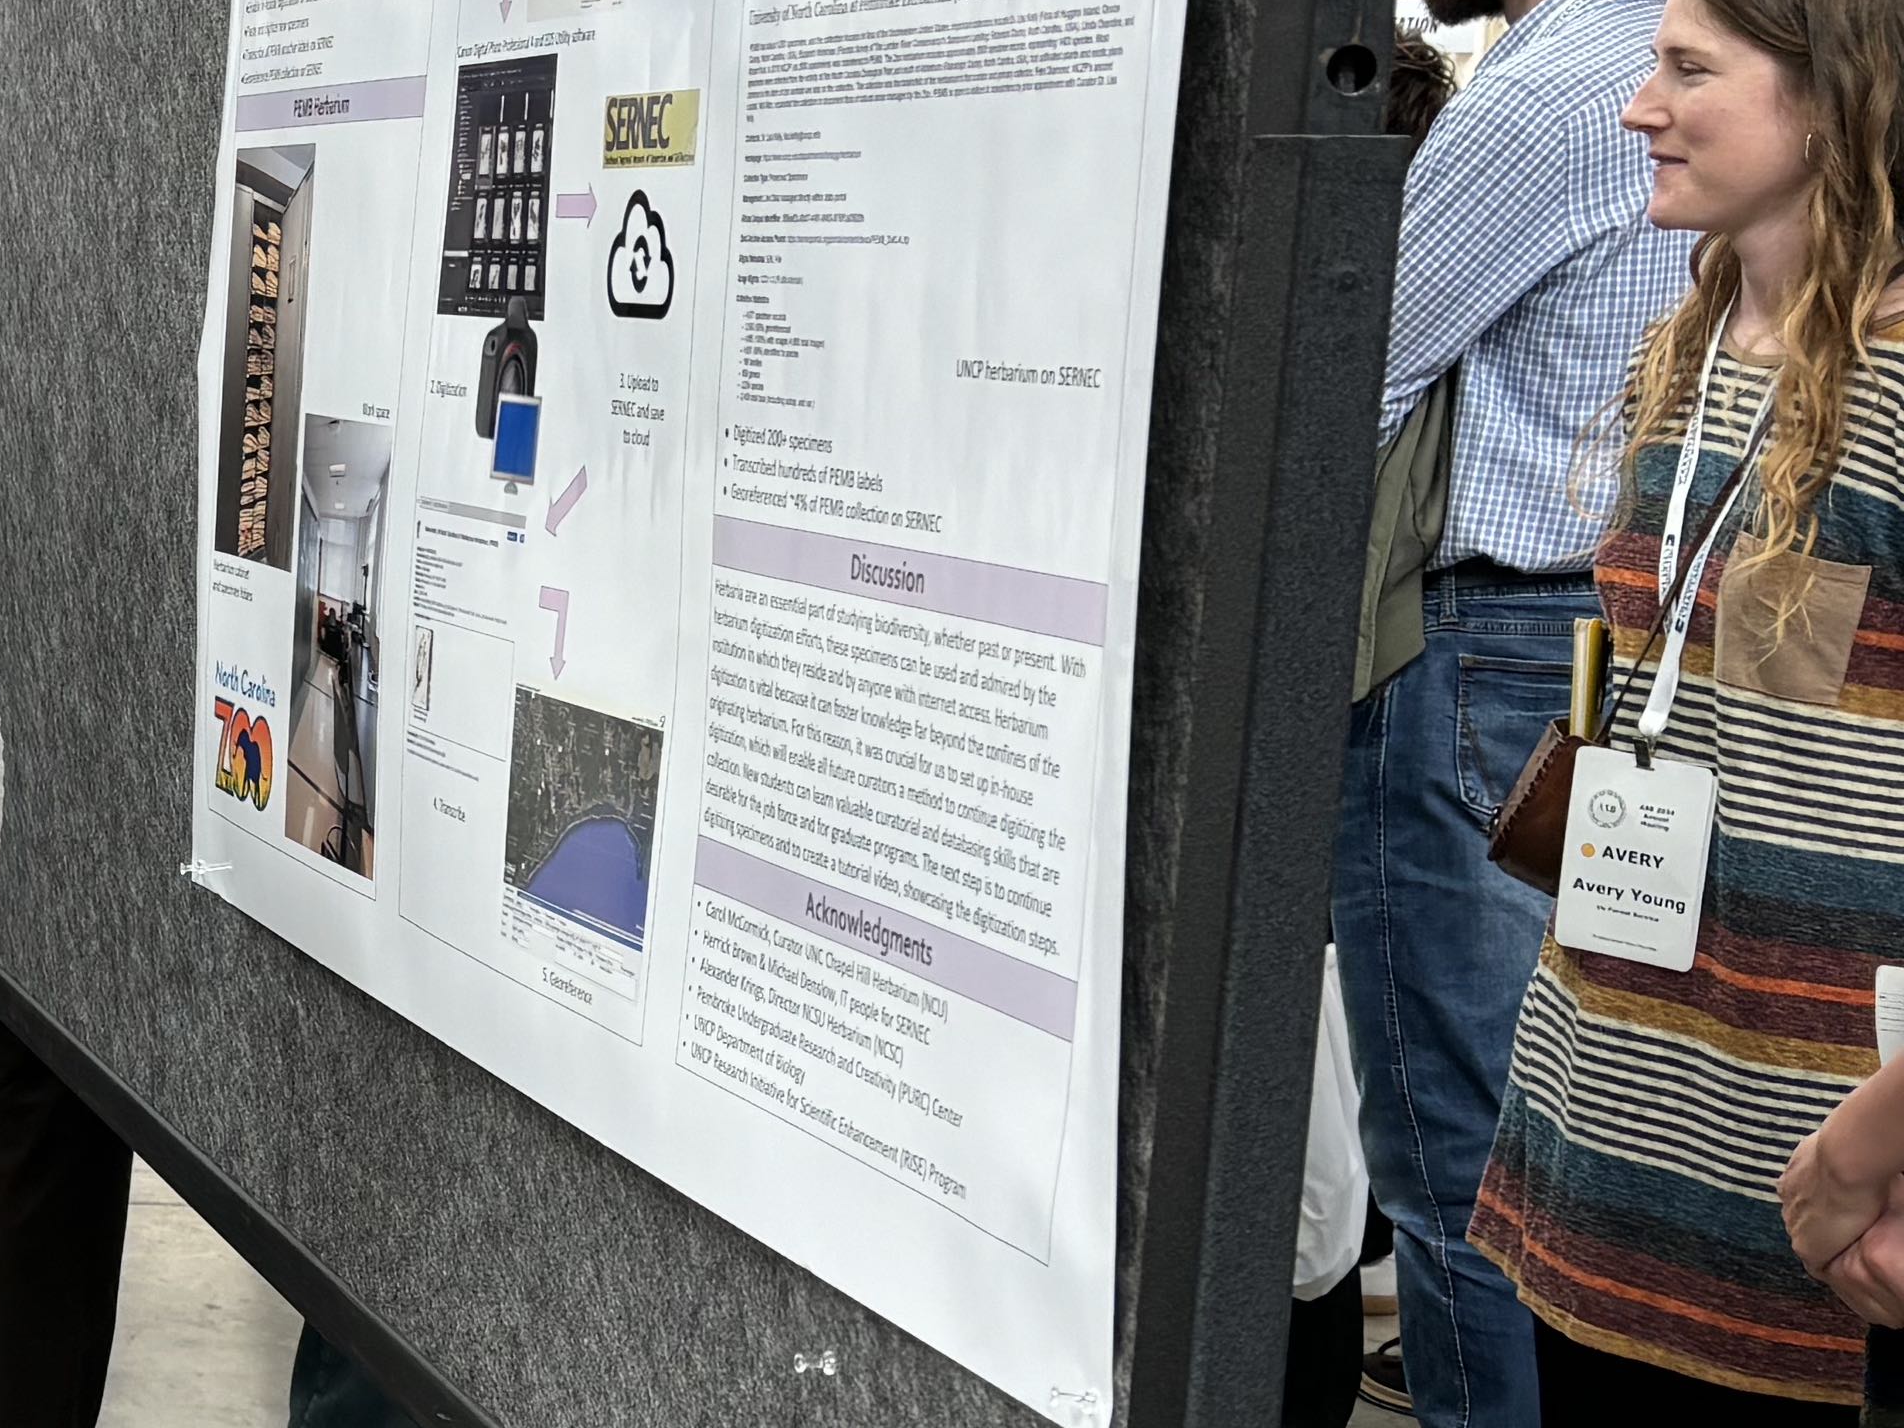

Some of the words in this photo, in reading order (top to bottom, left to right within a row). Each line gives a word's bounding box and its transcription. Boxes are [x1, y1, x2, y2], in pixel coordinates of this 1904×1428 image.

[604, 92, 672, 152] SERNEC
[956, 360, 983, 378] UNCP
[1040, 370, 1055, 383] on
[1058, 366, 1101, 387] SERNEC
[733, 424, 766, 445] Digitized
[788, 436, 832, 452] specimens
[732, 454, 776, 475] Transcribed
[777, 461, 816, 481] hundreds
[818, 466, 828, 483] of
[829, 468, 854, 487] PEMB
[856, 471, 882, 491] labels
[731, 483, 788, 507] Georeferenced
[809, 495, 818, 511] of
[819, 497, 844, 516] PEMB
[845, 502, 889, 522] collection
[891, 512, 903, 525] on
[904, 511, 942, 532] SERNEC
[850, 554, 924, 591] Discussion
[214, 662, 238, 690] North
[240, 670, 275, 706] Carolina
[214, 697, 273, 812] ZOO
[1602, 846, 1665, 869] AVERY
[1573, 877, 1624, 900] Avery
[1631, 888, 1686, 914] Young
[805, 894, 932, 964] Acknowledgments
[703, 931, 730, 953] Herrick
[731, 942, 756, 965] Brown
[759, 953, 765, 969] &
[767, 957, 798, 984] Michael
[839, 989, 848, 1006] IT
[849, 998, 878, 1021] people
[881, 1006, 893, 1026] for
[895, 1014, 930, 1044] SERNEC
[706, 901, 725, 921] Carol
[773, 930, 802, 954] Curator
[805, 944, 822, 965] UNC
[825, 952, 853, 977] Chapel
[855, 964, 870, 984] Hill
[872, 972, 918, 1005] Herbarium
[921, 992, 948, 1022] (NCU)
[699, 958, 737, 986] Alexander
[768, 988, 799, 1013] Director
[802, 1003, 825, 1026] NCSU
[826, 1015, 871, 1048] Herbarium
[873, 1035, 903, 1067] (NCSC)
[694, 1014, 715, 1035] UNCP
[716, 1025, 763, 1061] Department
[765, 1050, 774, 1065] of
[775, 1054, 804, 1084] Biology
[696, 985, 735, 1016] Pembroke
[737, 1005, 796, 1045] Undergraduate
[798, 1033, 835, 1063] Research
[837, 1056, 854, 1073] and
[855, 1061, 895, 1097] Creativity
[898, 1081, 929, 1114] (PURC)
[932, 1098, 962, 1126] Center
[713, 1053, 747, 1083] Research
[749, 1072, 784, 1102] Initiative
[786, 1088, 799, 1108] for
[800, 1097, 836, 1129] Scientific
[838, 1117, 897, 1161] Enhancement
[899, 1149, 926, 1180] (RISE)
[929, 1163, 965, 1197] Program
